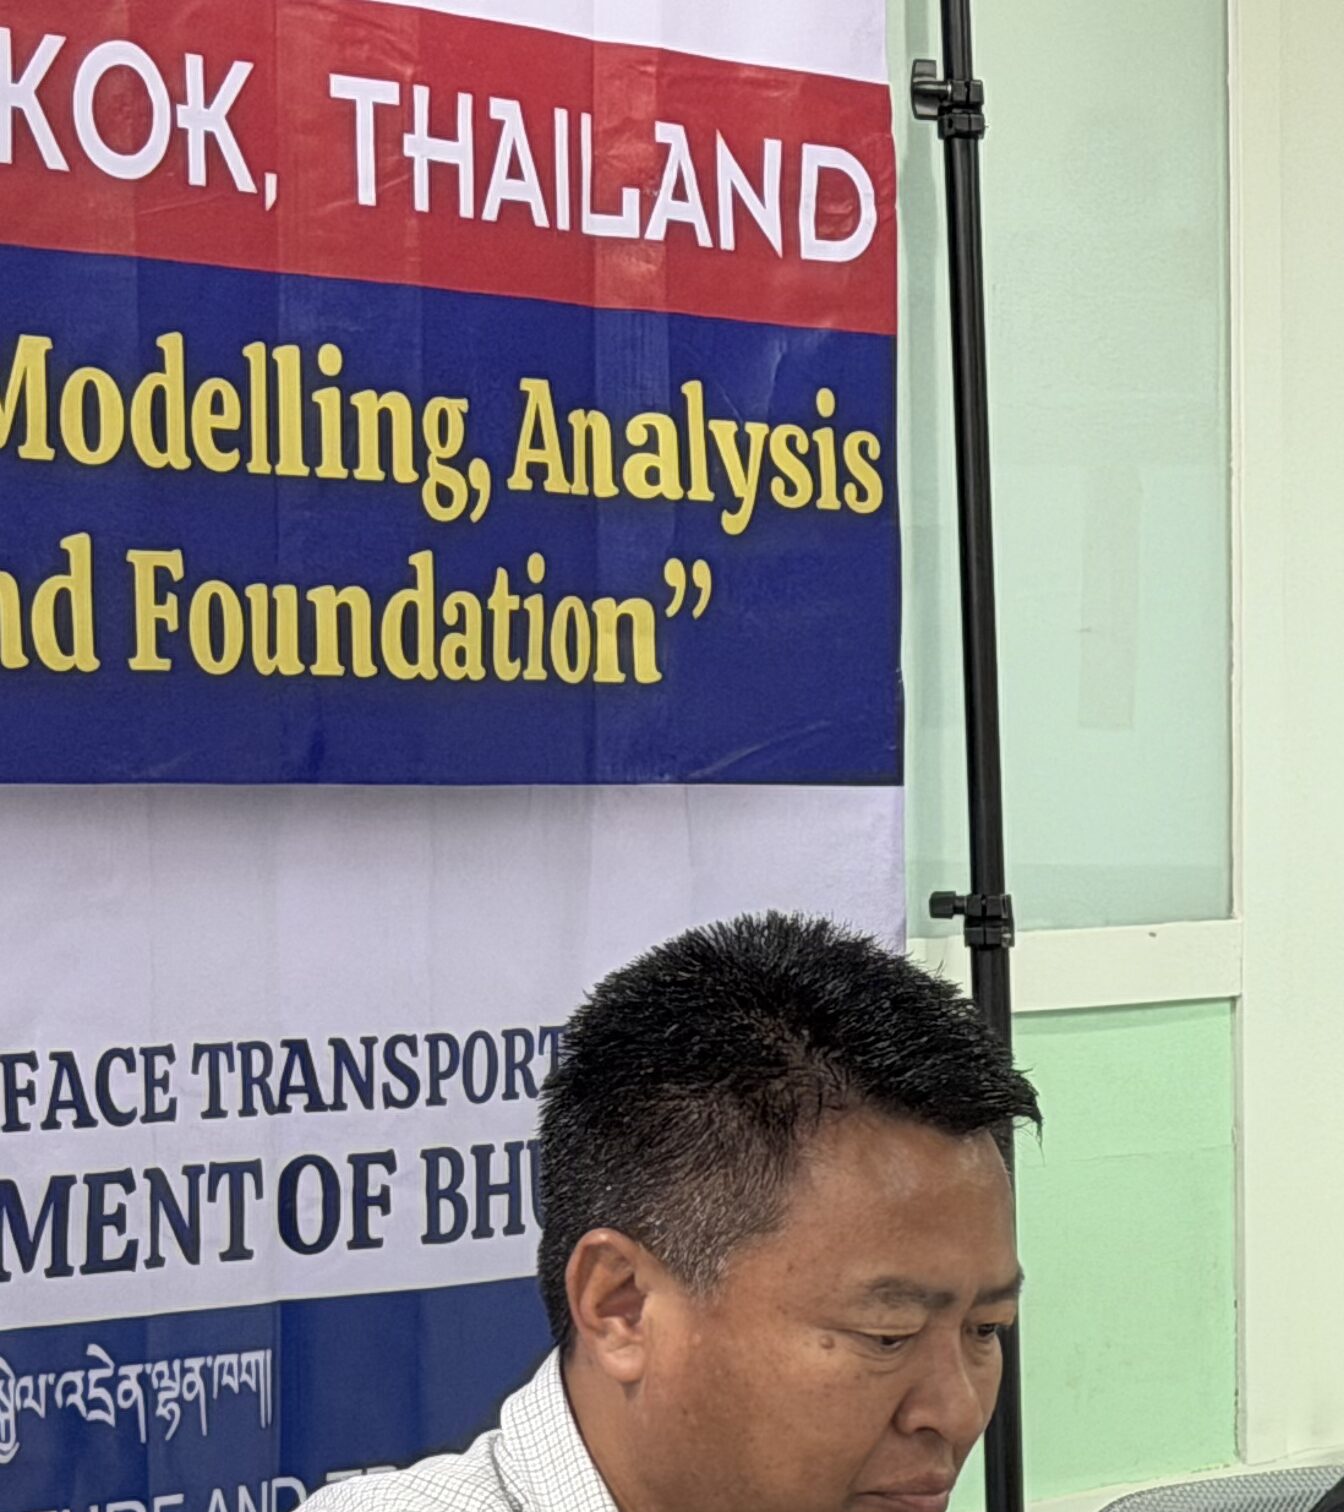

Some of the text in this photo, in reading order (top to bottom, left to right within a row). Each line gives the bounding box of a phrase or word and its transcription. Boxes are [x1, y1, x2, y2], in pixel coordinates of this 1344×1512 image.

[329, 74, 879, 263] THAILAND
[0, 332, 885, 537] Modelling, Analysis
[127, 548, 712, 686] Foundation”
[0, 1042, 178, 1133] FACE
[0, 1158, 264, 1283] MENT
[277, 1149, 397, 1255] OF
